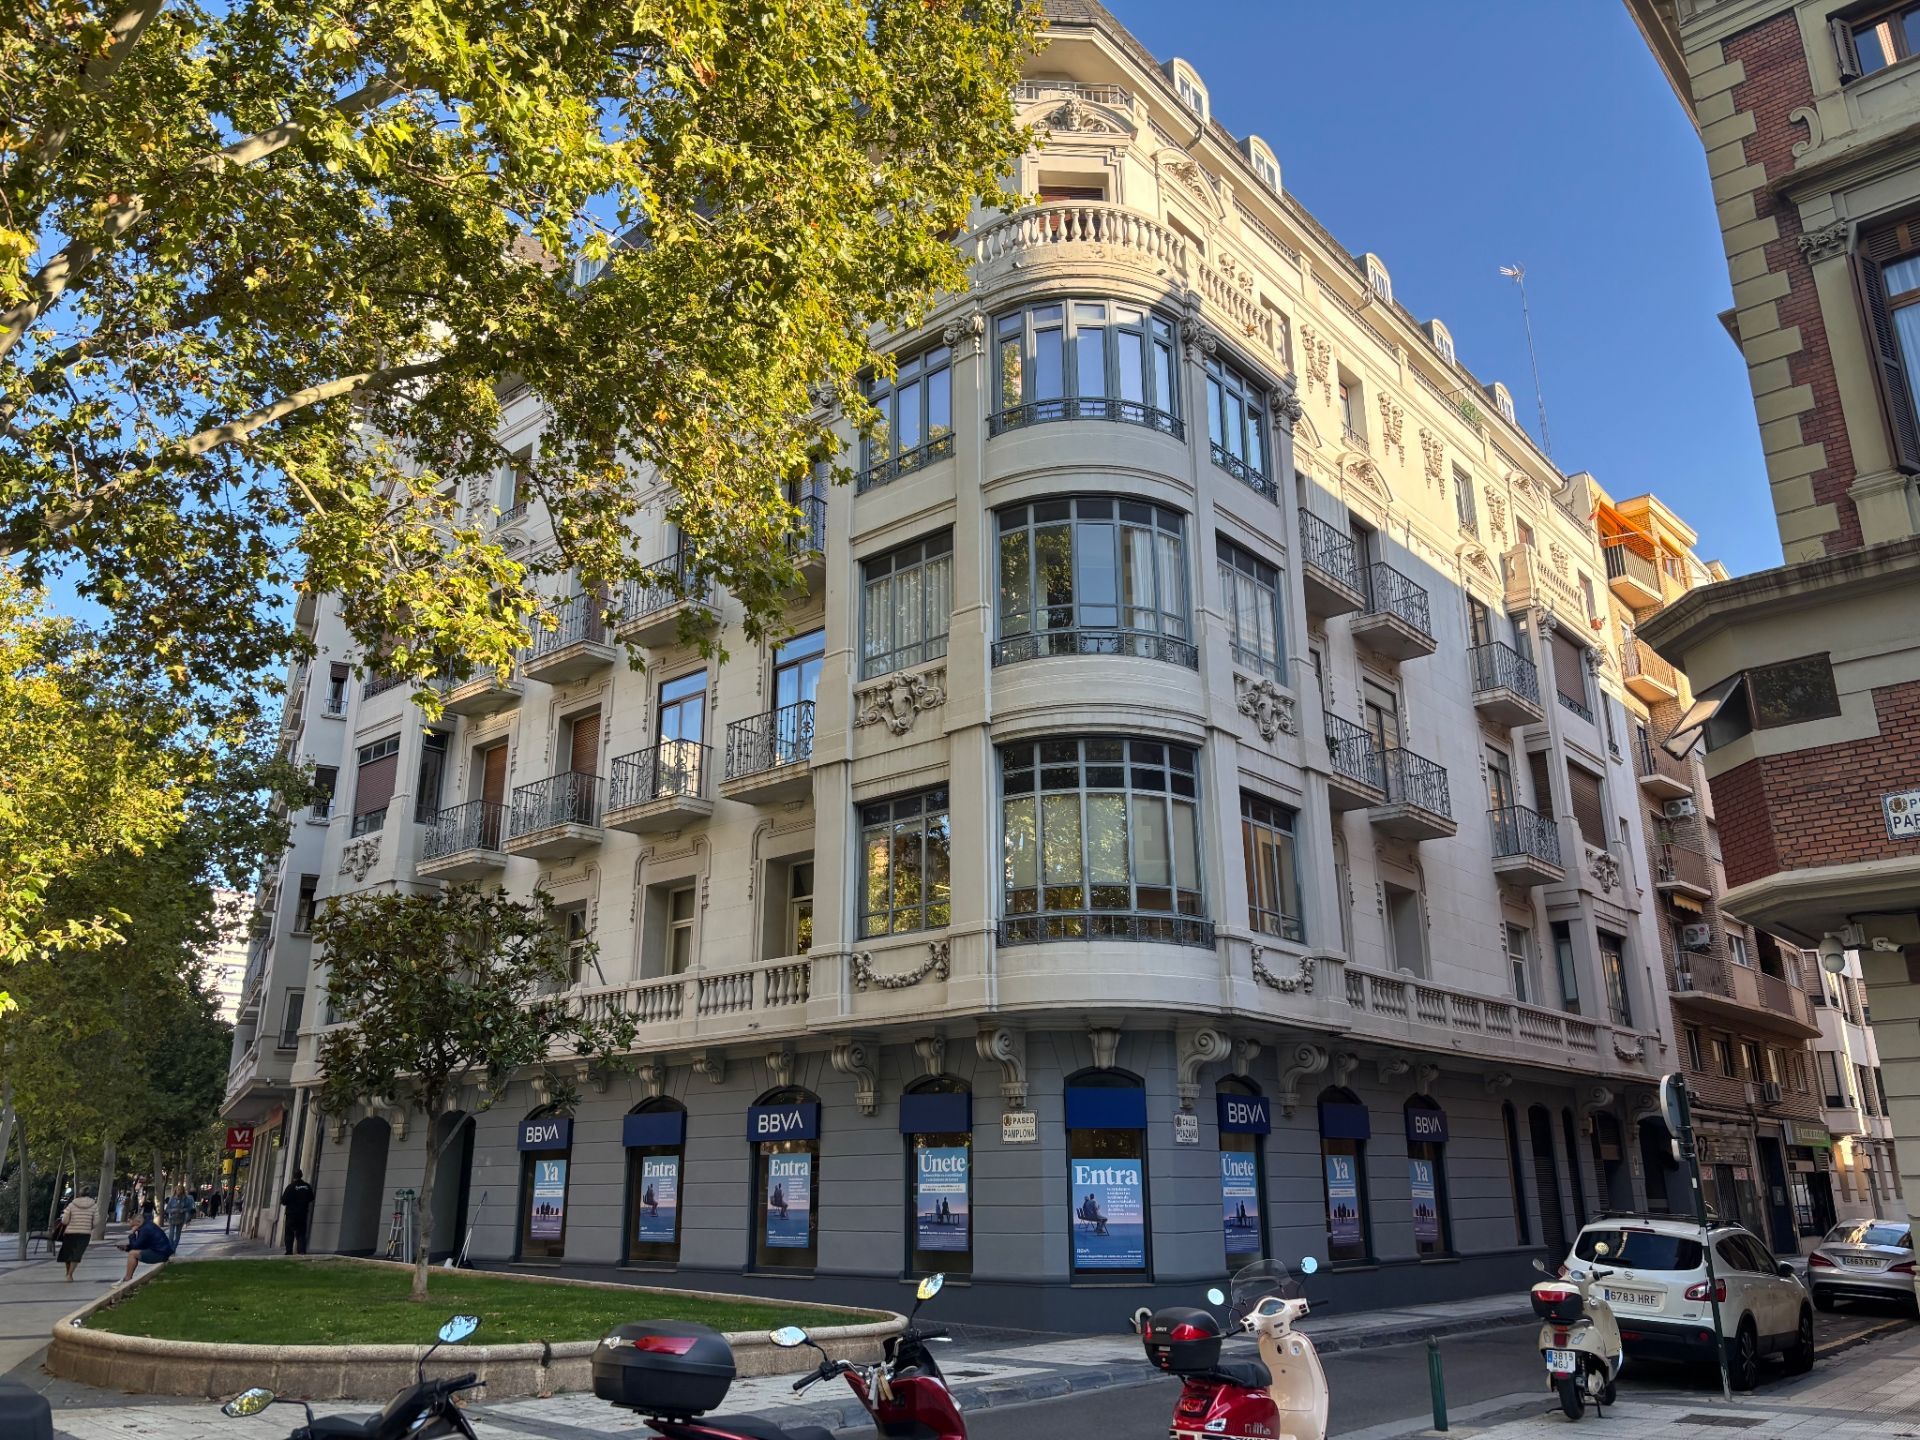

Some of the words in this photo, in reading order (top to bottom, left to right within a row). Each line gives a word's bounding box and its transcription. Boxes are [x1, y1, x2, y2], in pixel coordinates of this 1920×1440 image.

[758, 1110, 804, 1133] BBVA
[1012, 1116, 1035, 1125] PASEO
[1227, 1102, 1266, 1124] BBVA
[525, 1123, 559, 1143] BBVA
[1003, 1128, 1035, 1139] PAMPLONA
[1415, 1116, 1442, 1134] BBVA
[644, 1161, 677, 1178] Entra
[770, 1159, 809, 1177] Entra
[920, 1150, 966, 1173] Únete
[1222, 1153, 1254, 1177] Únete
[1332, 1157, 1349, 1180] Ya
[1414, 1161, 1429, 1182] Ya
[543, 1162, 559, 1182] Ya
[1074, 1165, 1139, 1186] Entra
[1611, 1291, 1635, 1302] 6783
[1638, 1294, 1656, 1305] HRF
